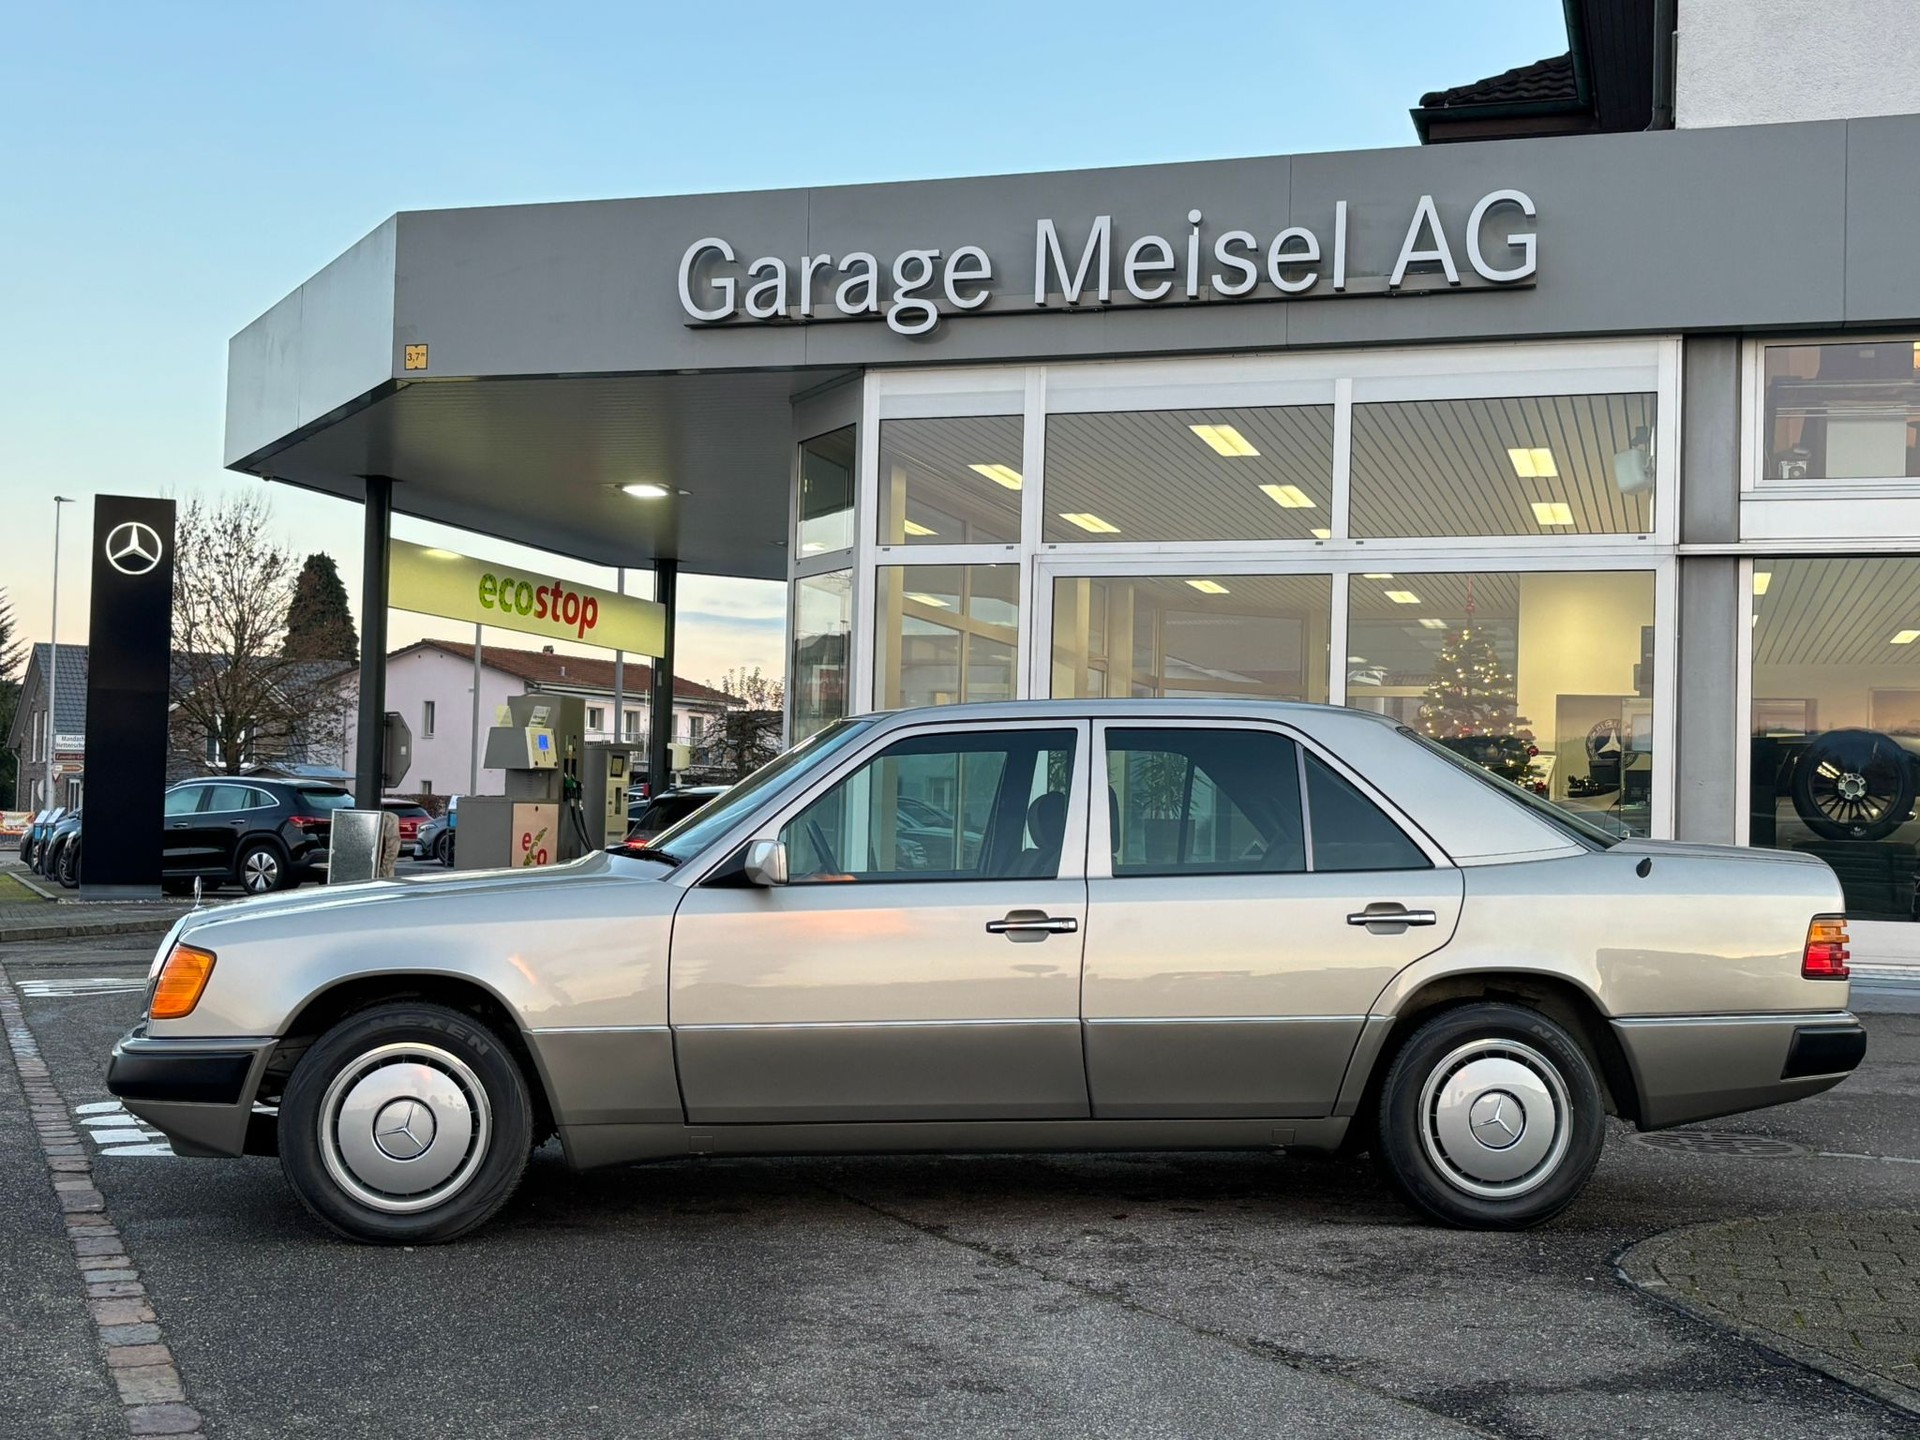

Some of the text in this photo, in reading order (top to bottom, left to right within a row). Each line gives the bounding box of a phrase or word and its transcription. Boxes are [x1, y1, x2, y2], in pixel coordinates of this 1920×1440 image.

[678, 189, 1537, 335] Garage Meisel AG
[478, 573, 598, 639] ecostop
[369, 1014, 490, 1056] NEXEN
